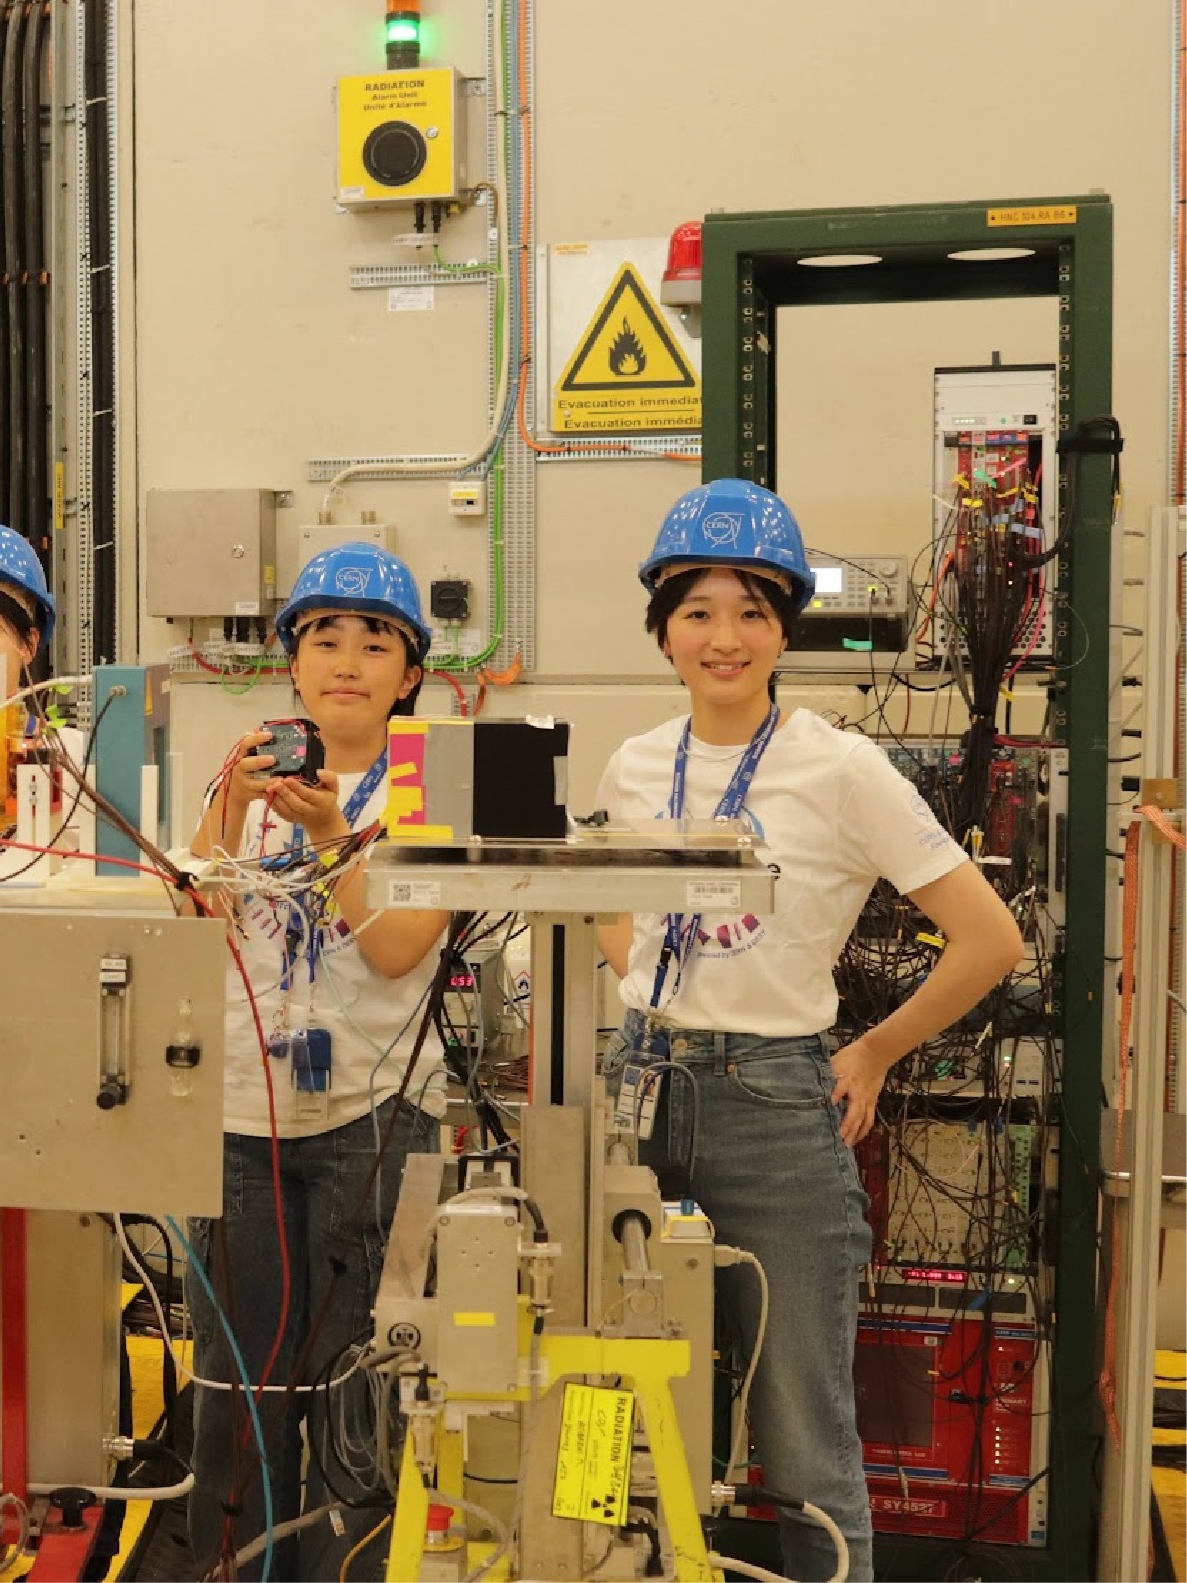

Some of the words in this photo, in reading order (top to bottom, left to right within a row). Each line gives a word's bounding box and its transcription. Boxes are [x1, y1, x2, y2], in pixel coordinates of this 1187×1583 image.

[365, 80, 425, 91] RADIATION
[558, 397, 635, 409] Evacuation
[564, 417, 642, 429] Evacuation
[646, 415, 702, 426] immédia
[610, 1396, 628, 1462] RADIATION
